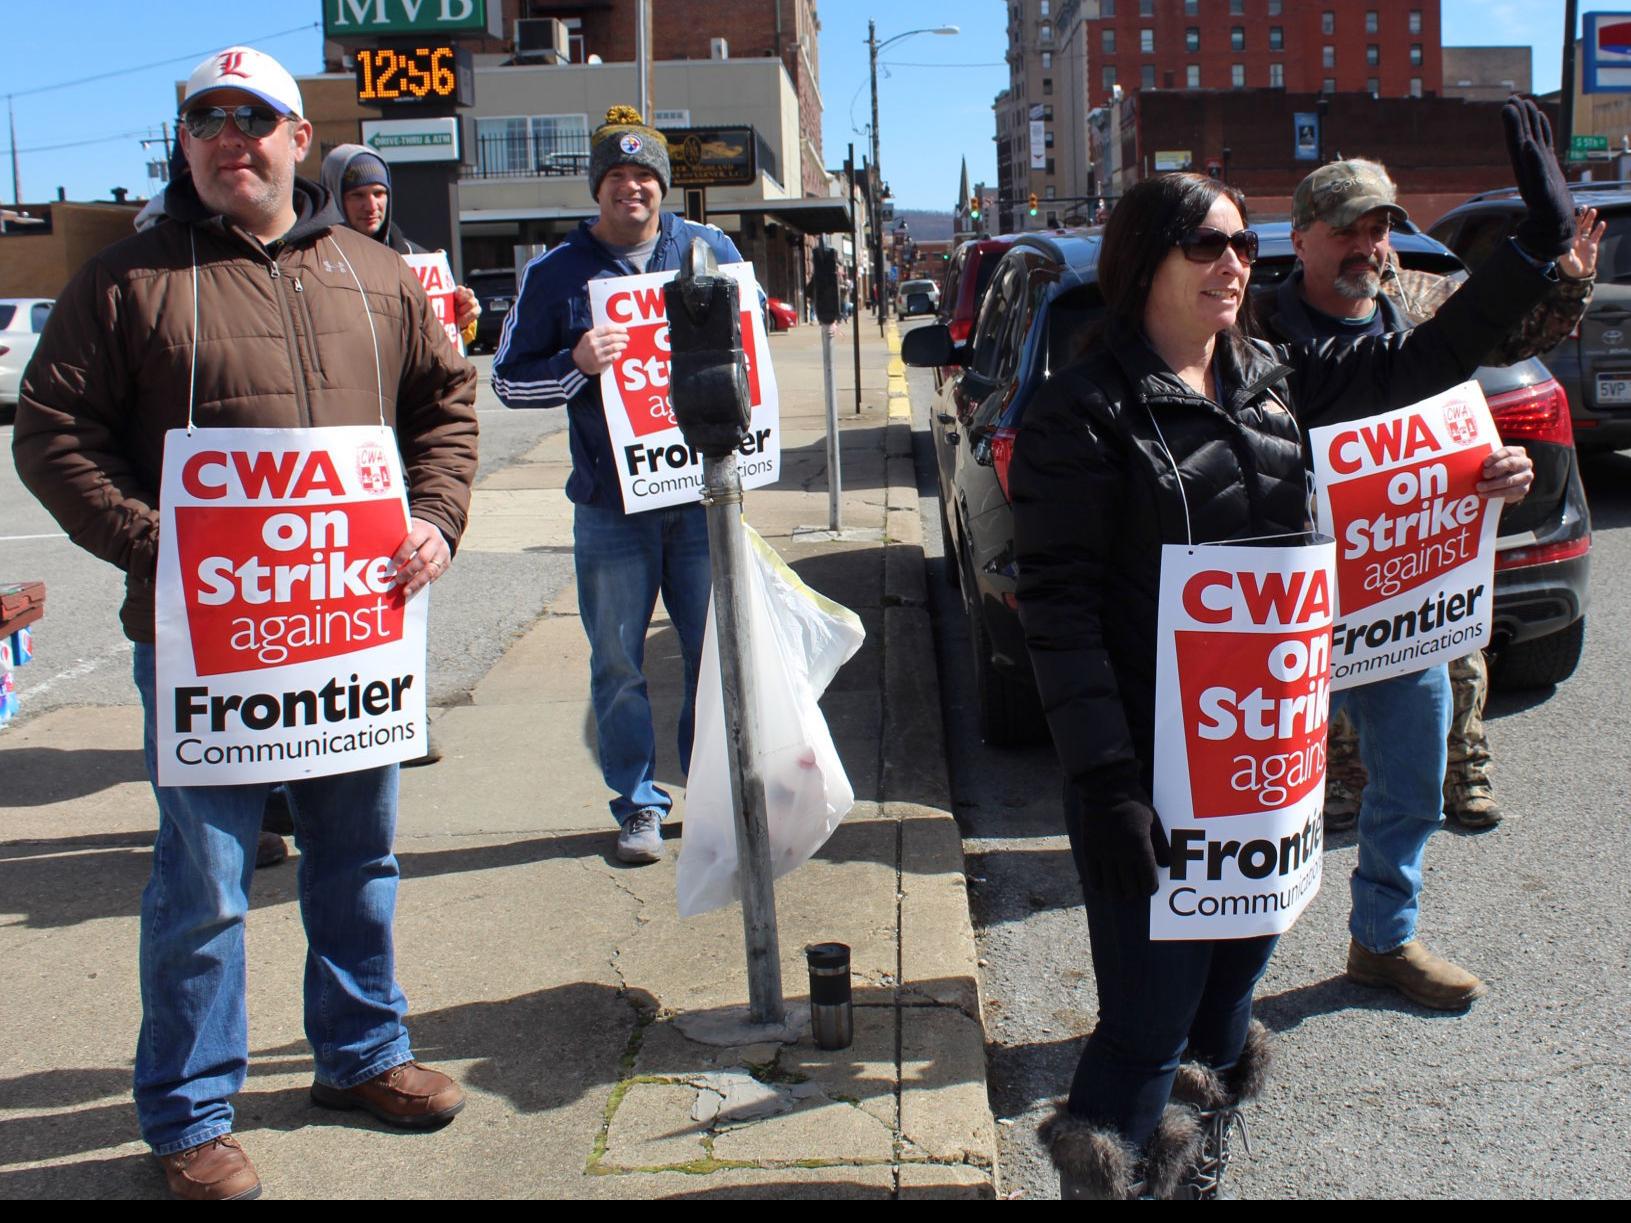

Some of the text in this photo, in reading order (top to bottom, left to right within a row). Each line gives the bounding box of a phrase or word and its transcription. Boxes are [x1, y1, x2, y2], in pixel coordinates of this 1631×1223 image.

[335, 0, 474, 25] MVB
[217, 51, 252, 79] L
[357, 47, 455, 98] 12:56
[605, 287, 667, 323] CW
[624, 427, 770, 476] Froer
[1328, 414, 1442, 475] CWA
[181, 450, 346, 500] CWA
[1386, 463, 1448, 506] on
[261, 509, 349, 551] on
[1344, 495, 1480, 560] Strike
[197, 551, 397, 606] Strike
[1363, 527, 1471, 596] against
[1181, 569, 1330, 625] CWA
[230, 596, 390, 664] against
[1267, 633, 1329, 683] on
[175, 673, 414, 733] Frontier
[1198, 677, 1329, 741] Strik
[175, 722, 416, 765] Communications
[1231, 736, 1327, 806] agains
[1169, 808, 1322, 881] Frontie
